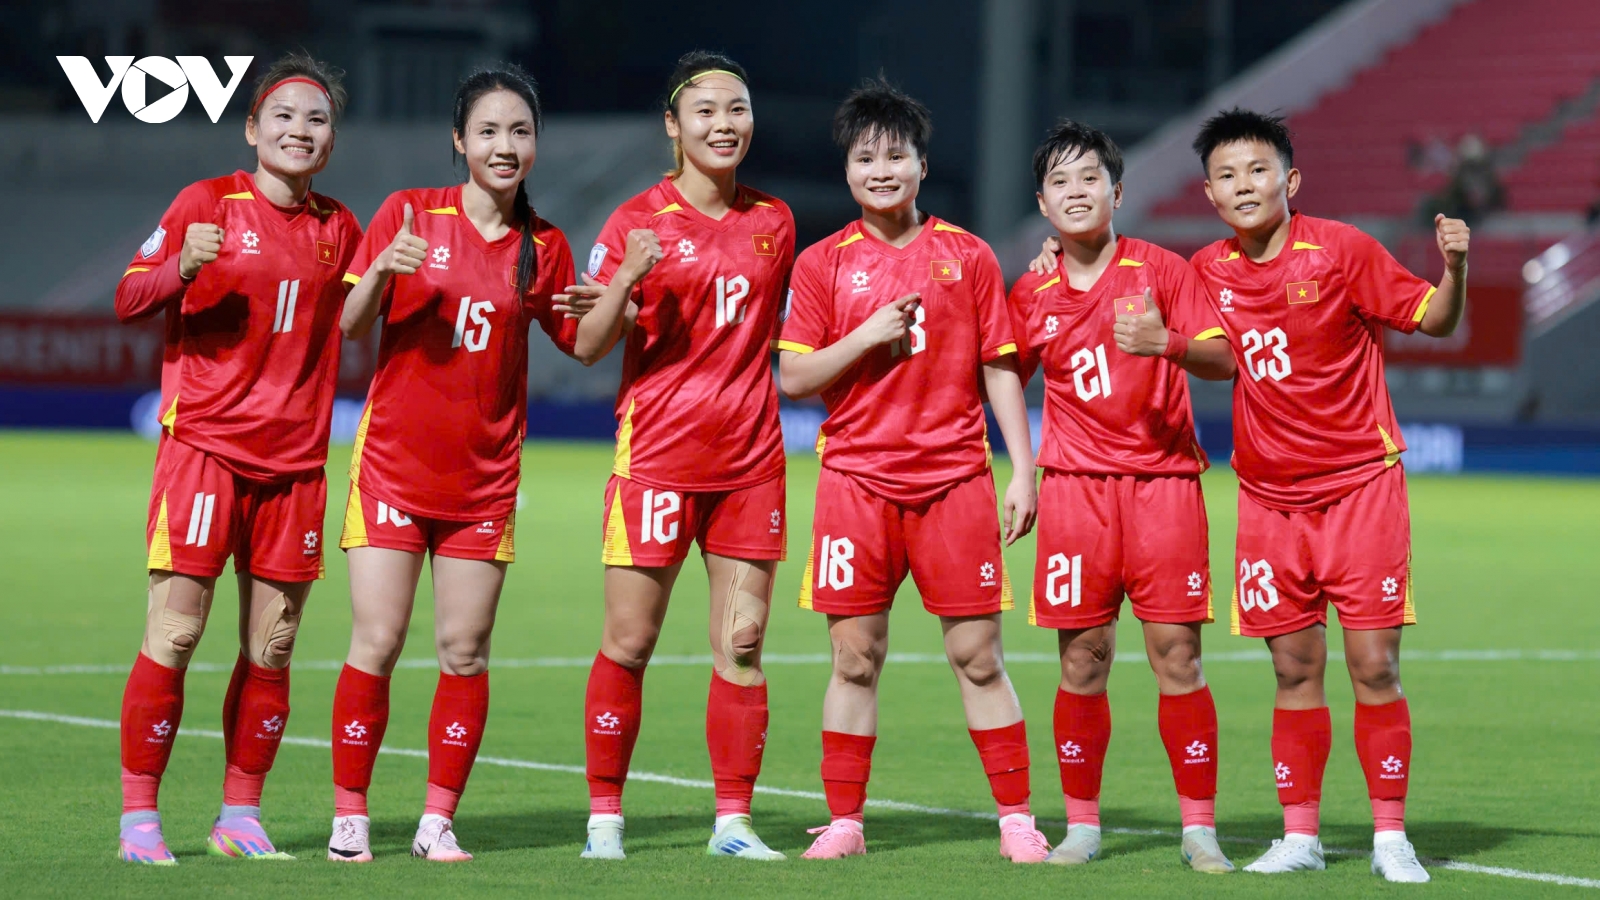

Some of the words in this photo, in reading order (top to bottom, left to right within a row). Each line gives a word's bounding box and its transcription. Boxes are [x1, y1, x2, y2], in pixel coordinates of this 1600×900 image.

[273, 280, 300, 333] 11
[452, 296, 496, 352] 15
[715, 274, 750, 329] 12
[891, 303, 926, 358] 8
[1241, 326, 1292, 382] 23
[1070, 344, 1112, 402] 21
[185, 492, 216, 547] 11
[641, 489, 681, 545] 12
[818, 534, 855, 591] 18
[1045, 552, 1082, 607] 21
[1239, 558, 1280, 612] 23
